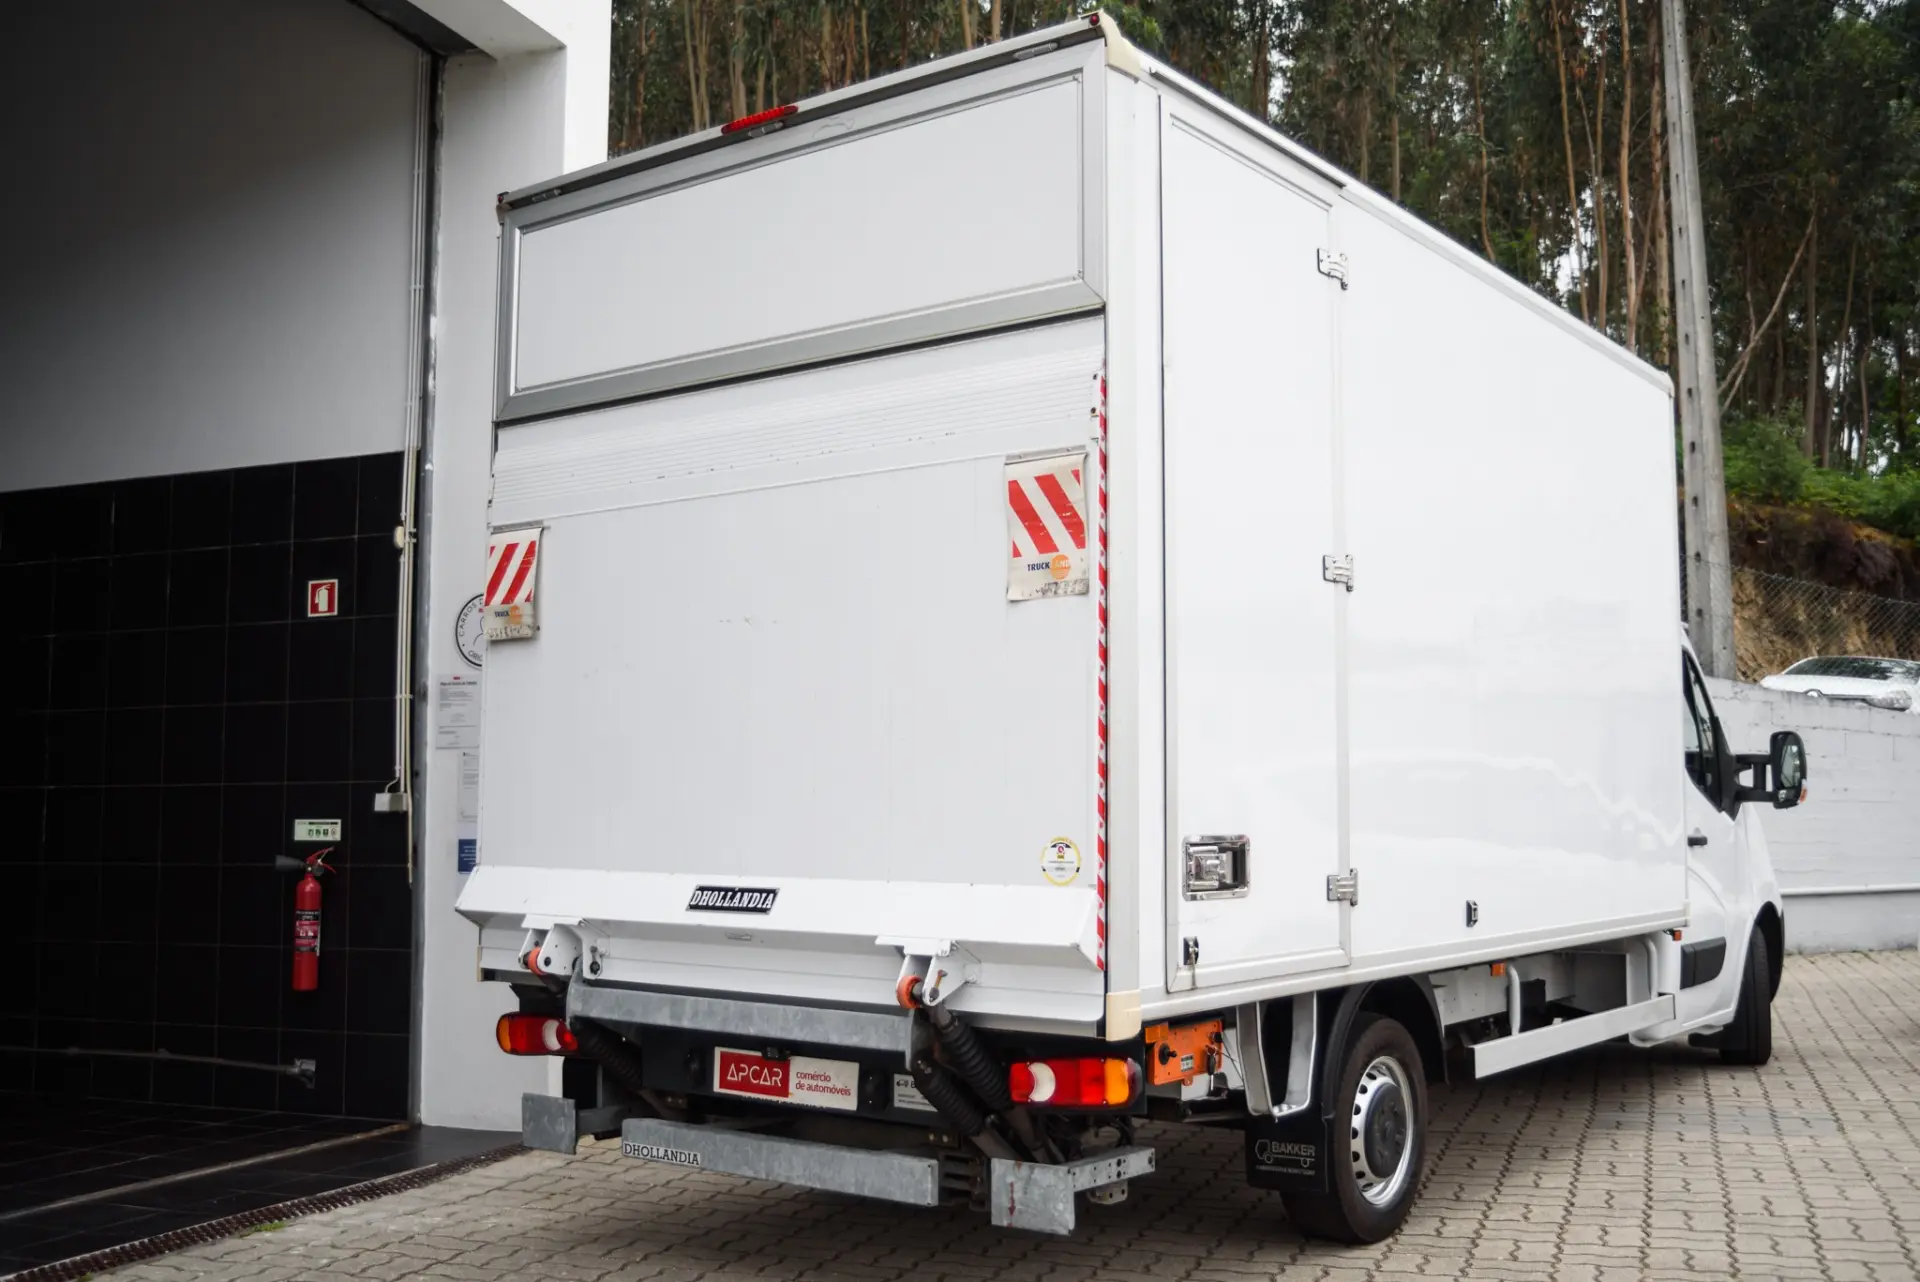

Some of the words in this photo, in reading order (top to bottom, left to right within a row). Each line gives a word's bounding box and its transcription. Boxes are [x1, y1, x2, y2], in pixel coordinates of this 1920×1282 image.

[1027, 562, 1050, 571] TRUCK
[459, 602, 477, 637] CARROS
[690, 890, 774, 909] DHOLLANDIA
[727, 1063, 783, 1087] APCAR
[796, 1071, 831, 1082] comércio
[796, 1081, 805, 1090] de
[806, 1085, 851, 1096] automóveis
[624, 1143, 699, 1165] DHOLLANDIA
[1271, 1141, 1316, 1156] BAKKER
